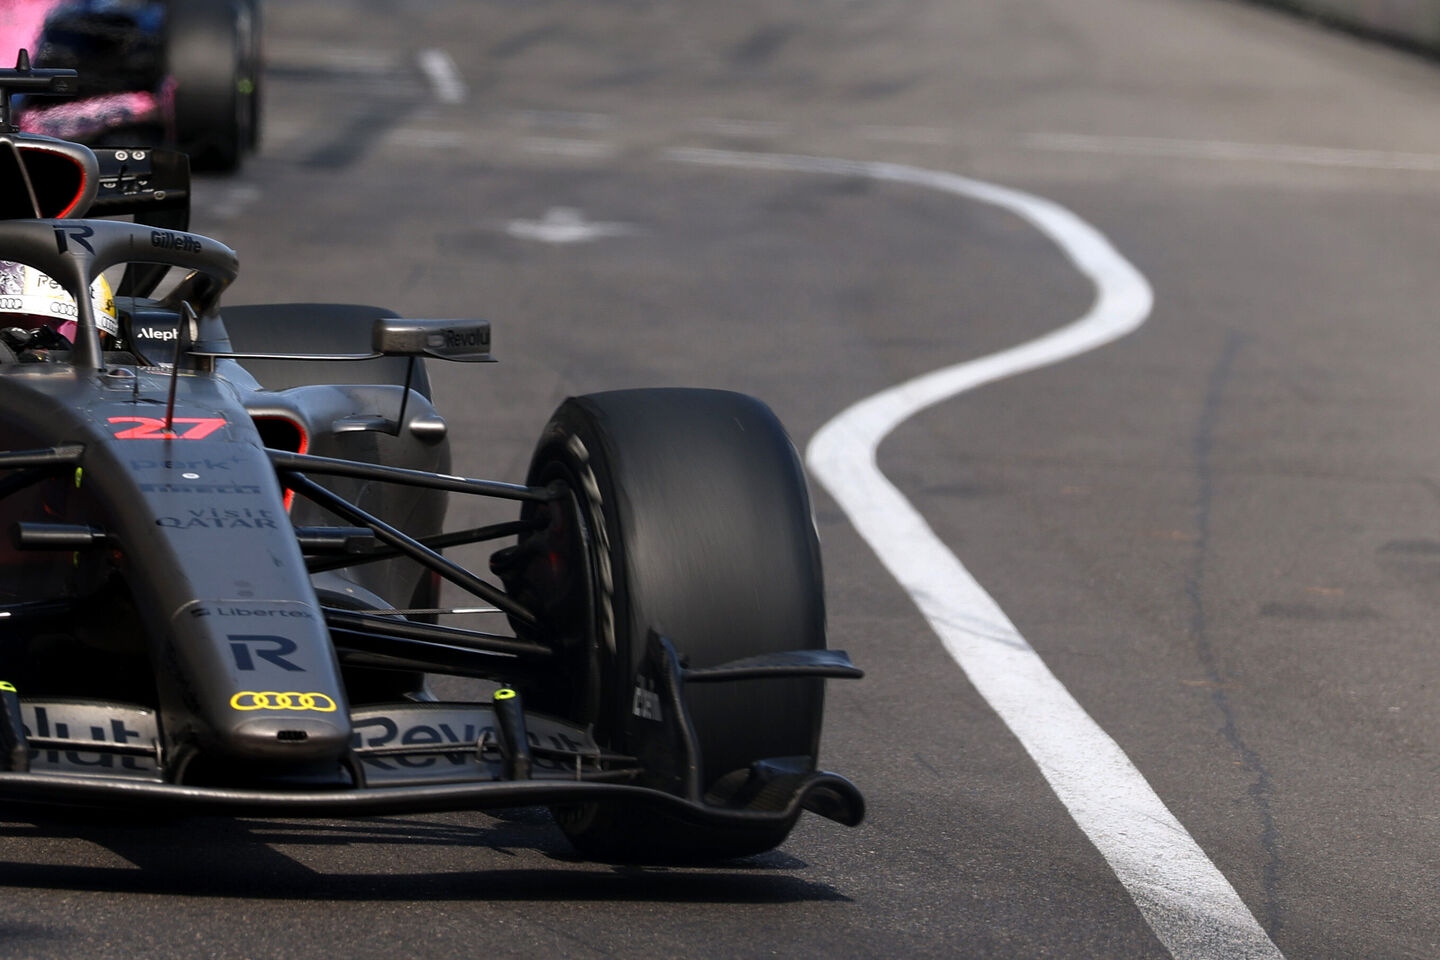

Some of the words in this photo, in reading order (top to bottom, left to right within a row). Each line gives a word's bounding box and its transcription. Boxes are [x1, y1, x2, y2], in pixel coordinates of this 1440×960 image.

[150, 230, 202, 253] Gillette
[444, 328, 490, 347] Revolu
[107, 416, 227, 439] 27
[155, 517, 278, 529] QATAR
[188, 507, 273, 518] visit
[217, 608, 313, 618] Libertex
[227, 634, 307, 672] R
[350, 716, 596, 772] Revut
